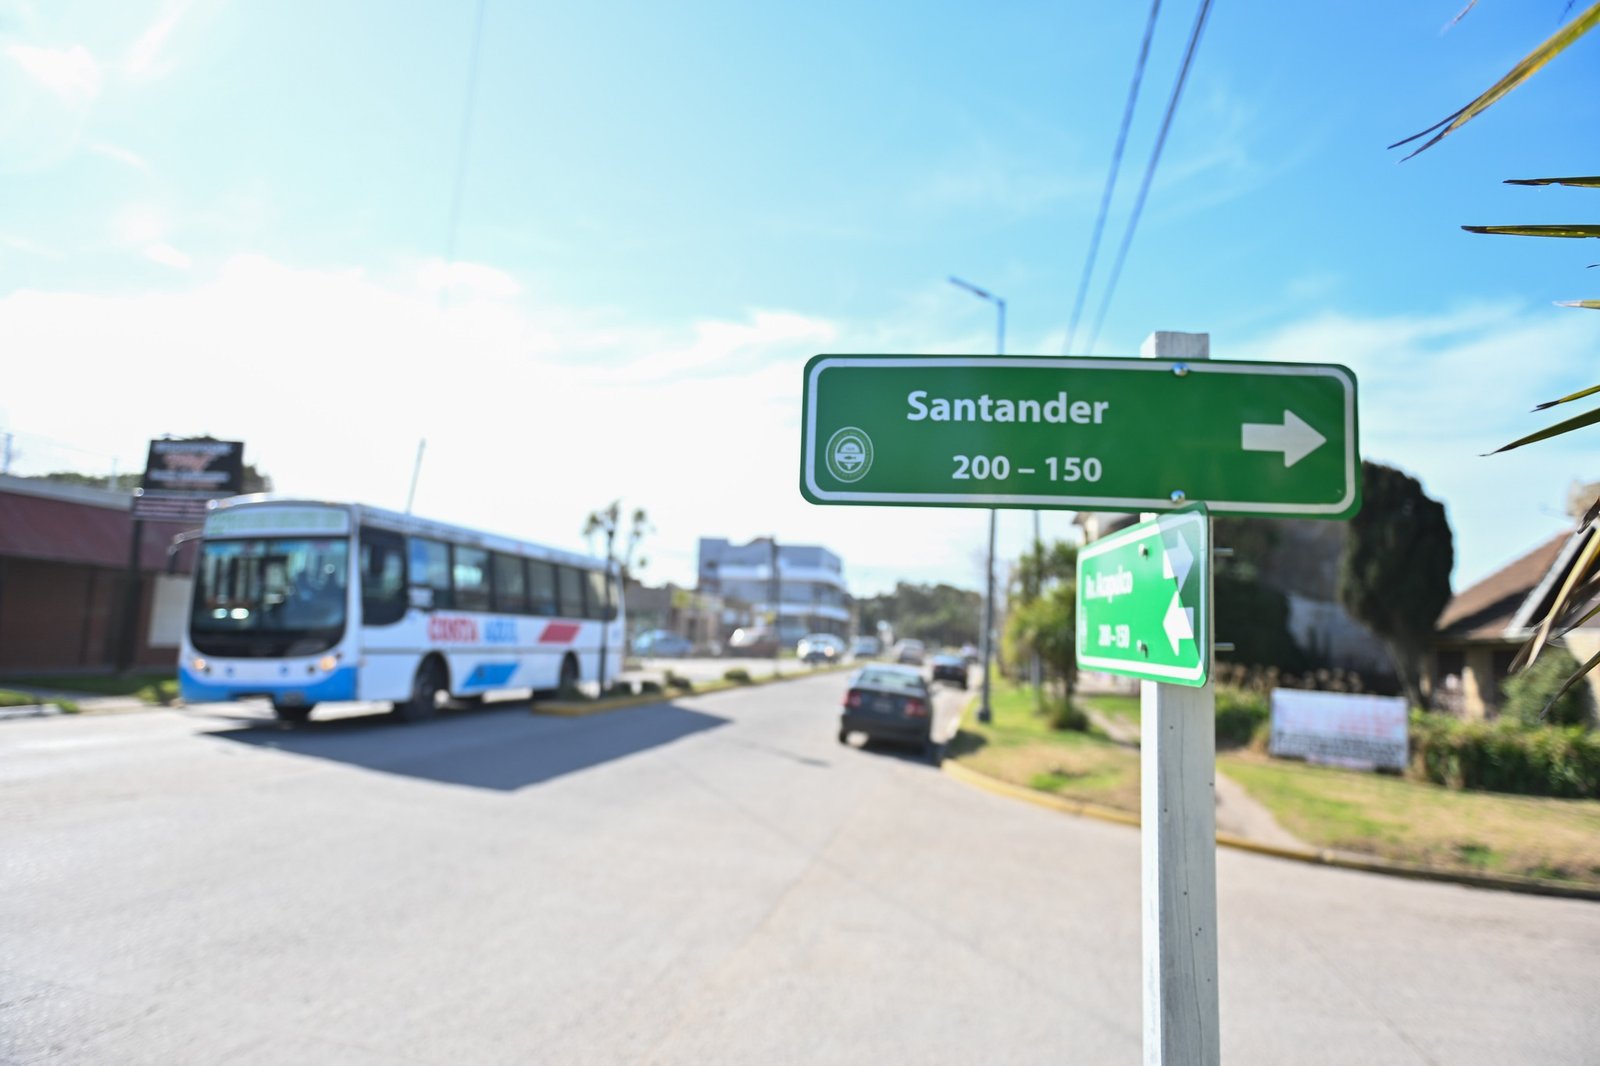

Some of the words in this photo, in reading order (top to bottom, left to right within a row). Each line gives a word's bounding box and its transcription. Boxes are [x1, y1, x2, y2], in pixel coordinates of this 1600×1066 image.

[907, 391, 1108, 423] Santander
[952, 455, 1011, 480] 200
[1045, 457, 1102, 482] 150
